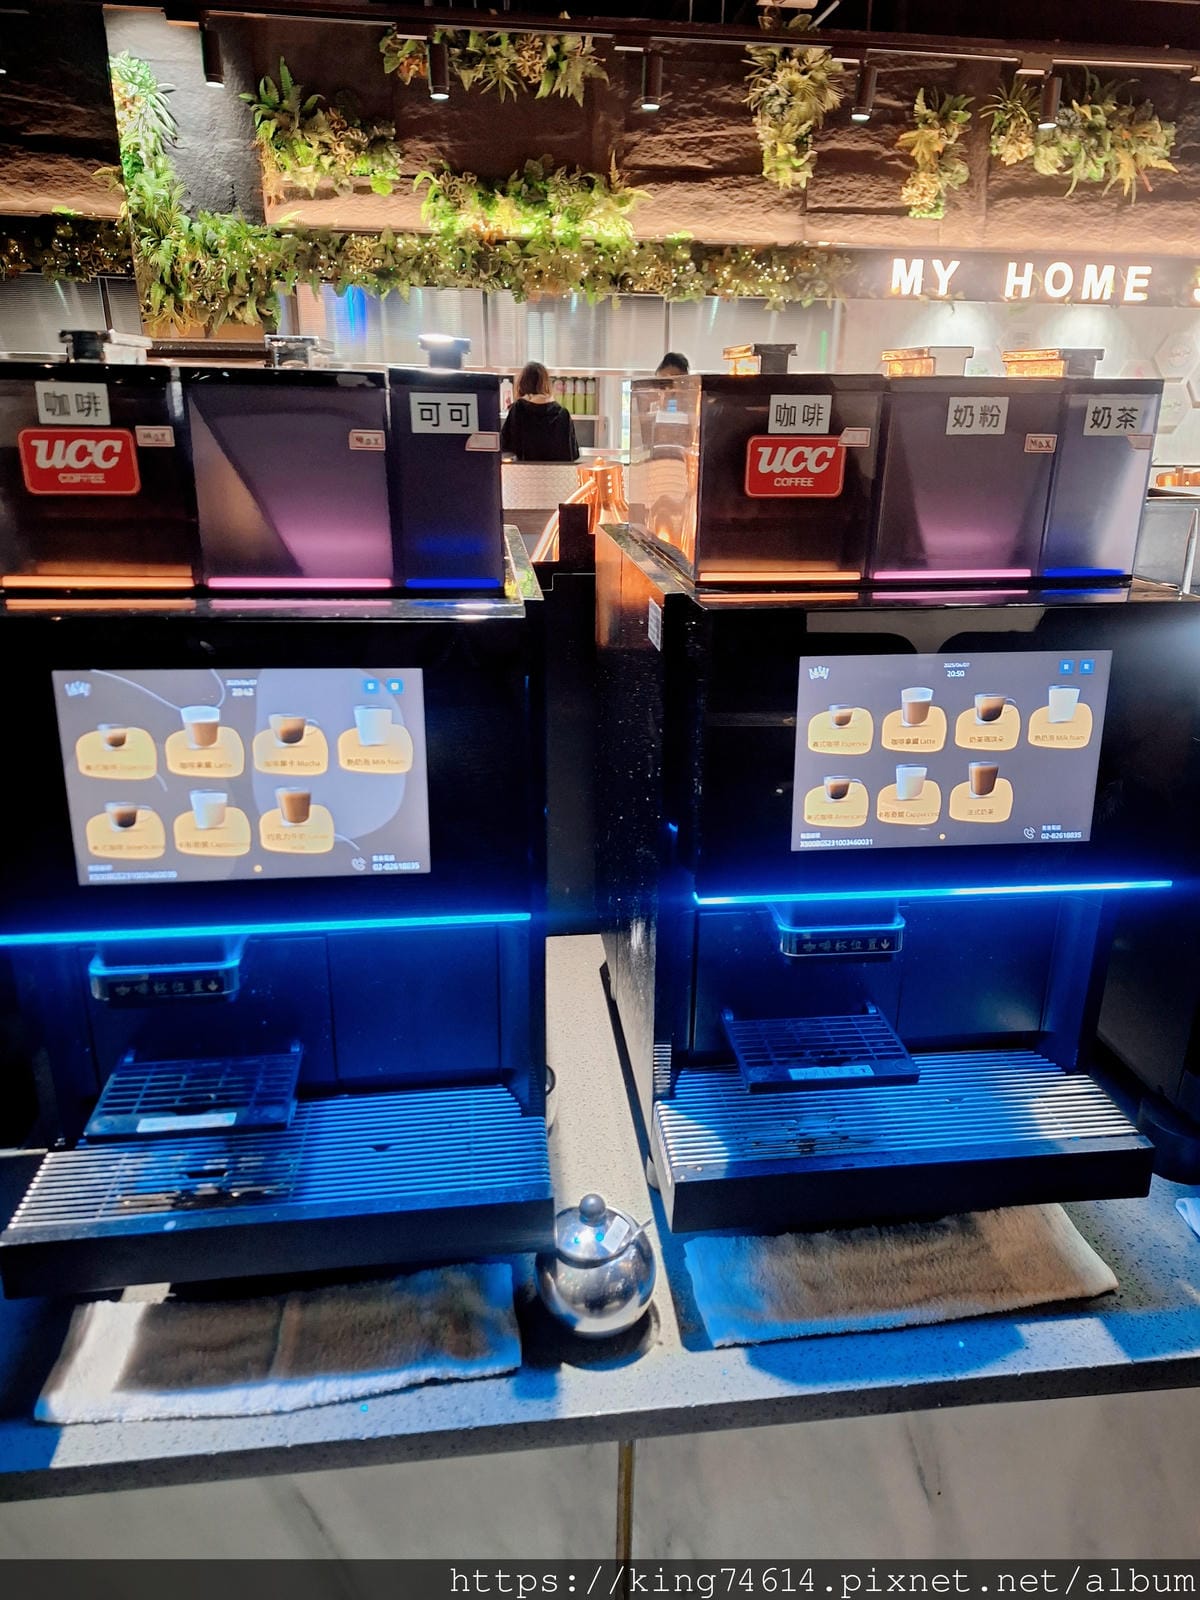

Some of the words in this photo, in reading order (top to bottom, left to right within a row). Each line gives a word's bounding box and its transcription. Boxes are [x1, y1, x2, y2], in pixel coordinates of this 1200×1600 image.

[891, 258, 961, 296] MY
[1004, 262, 1153, 301] HOME
[44, 391, 103, 417] 咖啡
[417, 402, 471, 427] 可可
[775, 403, 825, 427] 咖啡
[952, 404, 1002, 429] 奶粉
[1089, 406, 1139, 430] 奶茶
[773, 477, 815, 487] COFFEE
